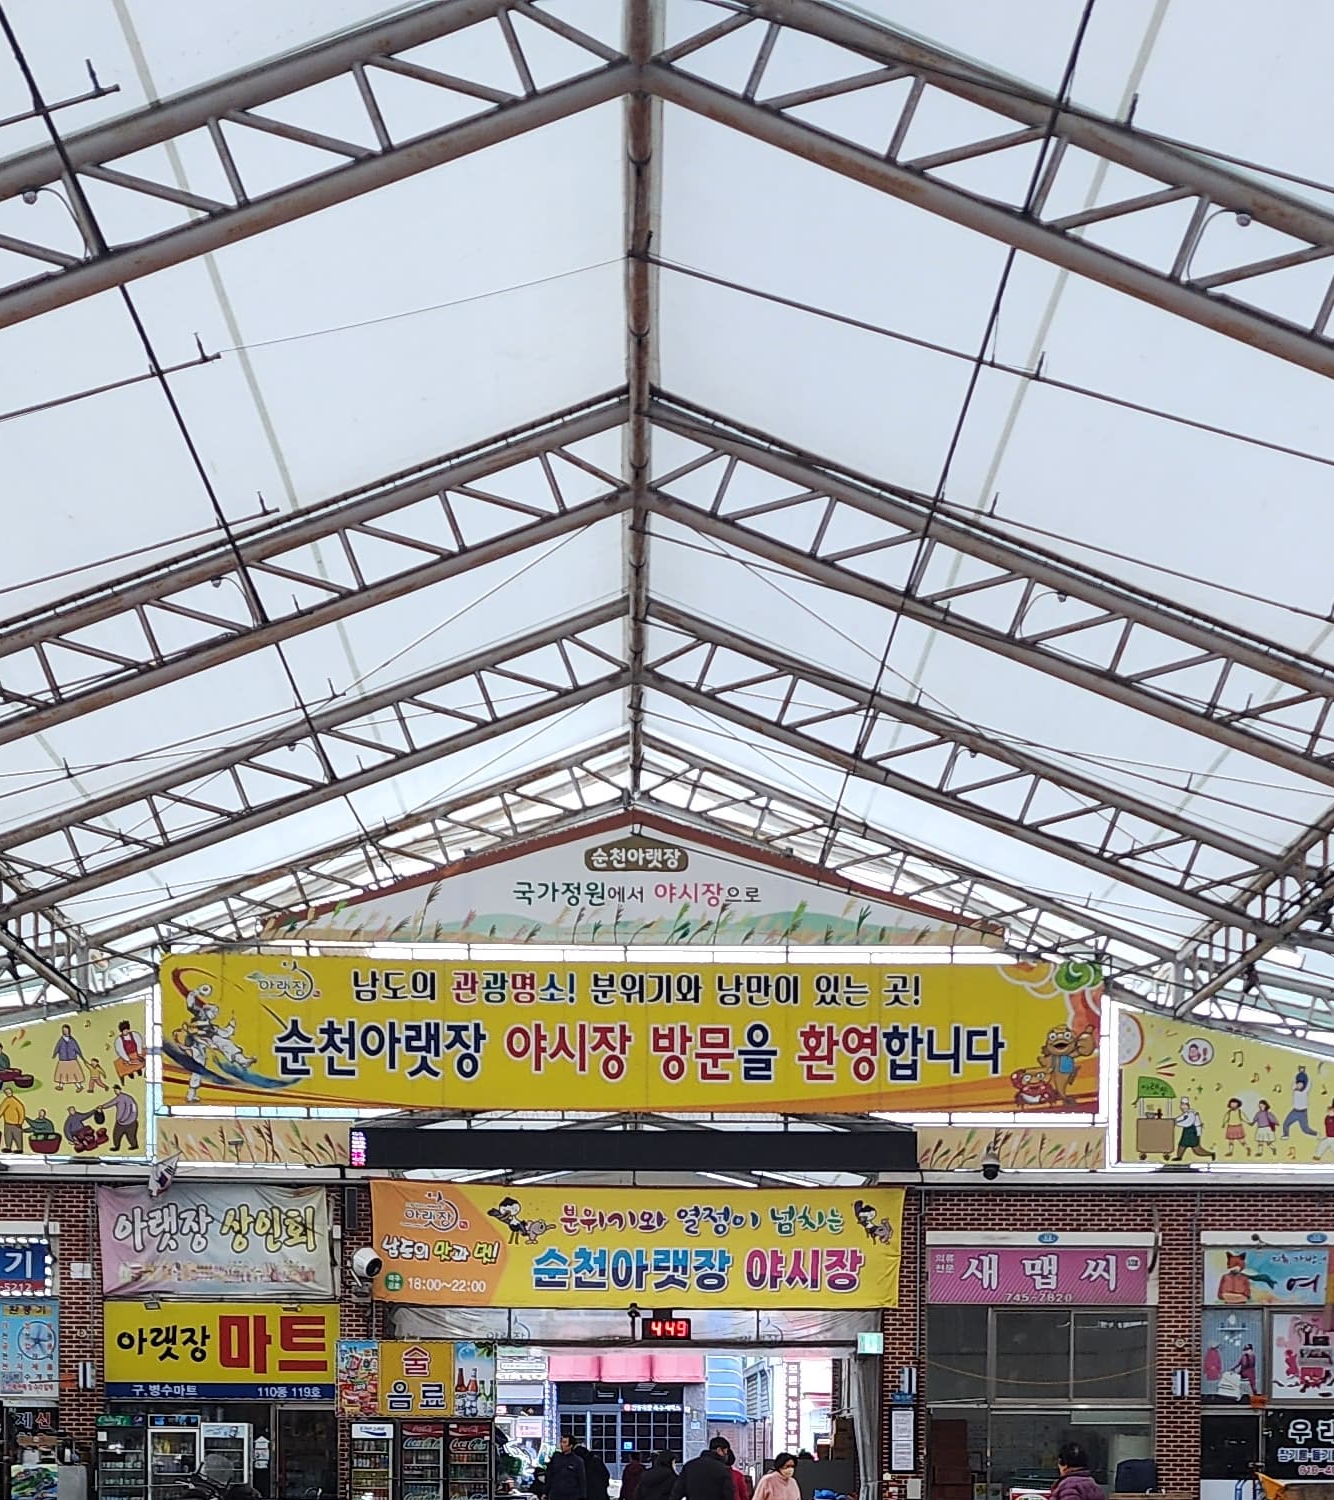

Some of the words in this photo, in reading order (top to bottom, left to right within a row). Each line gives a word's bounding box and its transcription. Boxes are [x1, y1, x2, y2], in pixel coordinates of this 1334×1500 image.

[589, 846, 682, 869] 순천아랫장
[513, 880, 644, 906] 국가정원에서
[654, 881, 763, 907] 야시장으로
[256, 977, 308, 999] 아랫장
[351, 970, 437, 1002] 남도의
[451, 970, 576, 1004] 관광명소!
[590, 972, 703, 1006] 분위기와
[717, 972, 800, 1006] 낭만이
[814, 972, 869, 1006] 있는
[883, 974, 922, 1006] 곳!
[273, 1017, 487, 1079] 순천아랫장
[505, 1021, 633, 1082] 야시장
[651, 1022, 779, 1082] 방문을
[796, 1022, 1006, 1083] 환영합니다
[113, 1202, 215, 1253] 아랫장
[219, 1203, 317, 1253] 상인회
[404, 1207, 453, 1228] 아랫장
[558, 1202, 668, 1235] 분위기와
[675, 1204, 760, 1237] 열정이
[769, 1204, 845, 1237] 넘치는
[381, 1234, 430, 1260] 남도의
[433, 1239, 470, 1263] 맛과
[407, 1276, 487, 1294] 18:00~22:00
[531, 1246, 732, 1293] 순천아랫장
[745, 1247, 865, 1293] 야시장
[116, 1323, 211, 1363] 아랫장
[218, 1314, 329, 1375] 마트
[402, 1345, 431, 1377] 술
[257, 1385, 289, 1398] 110동
[291, 1385, 323, 1398] 119호
[386, 1380, 447, 1412] 음료
